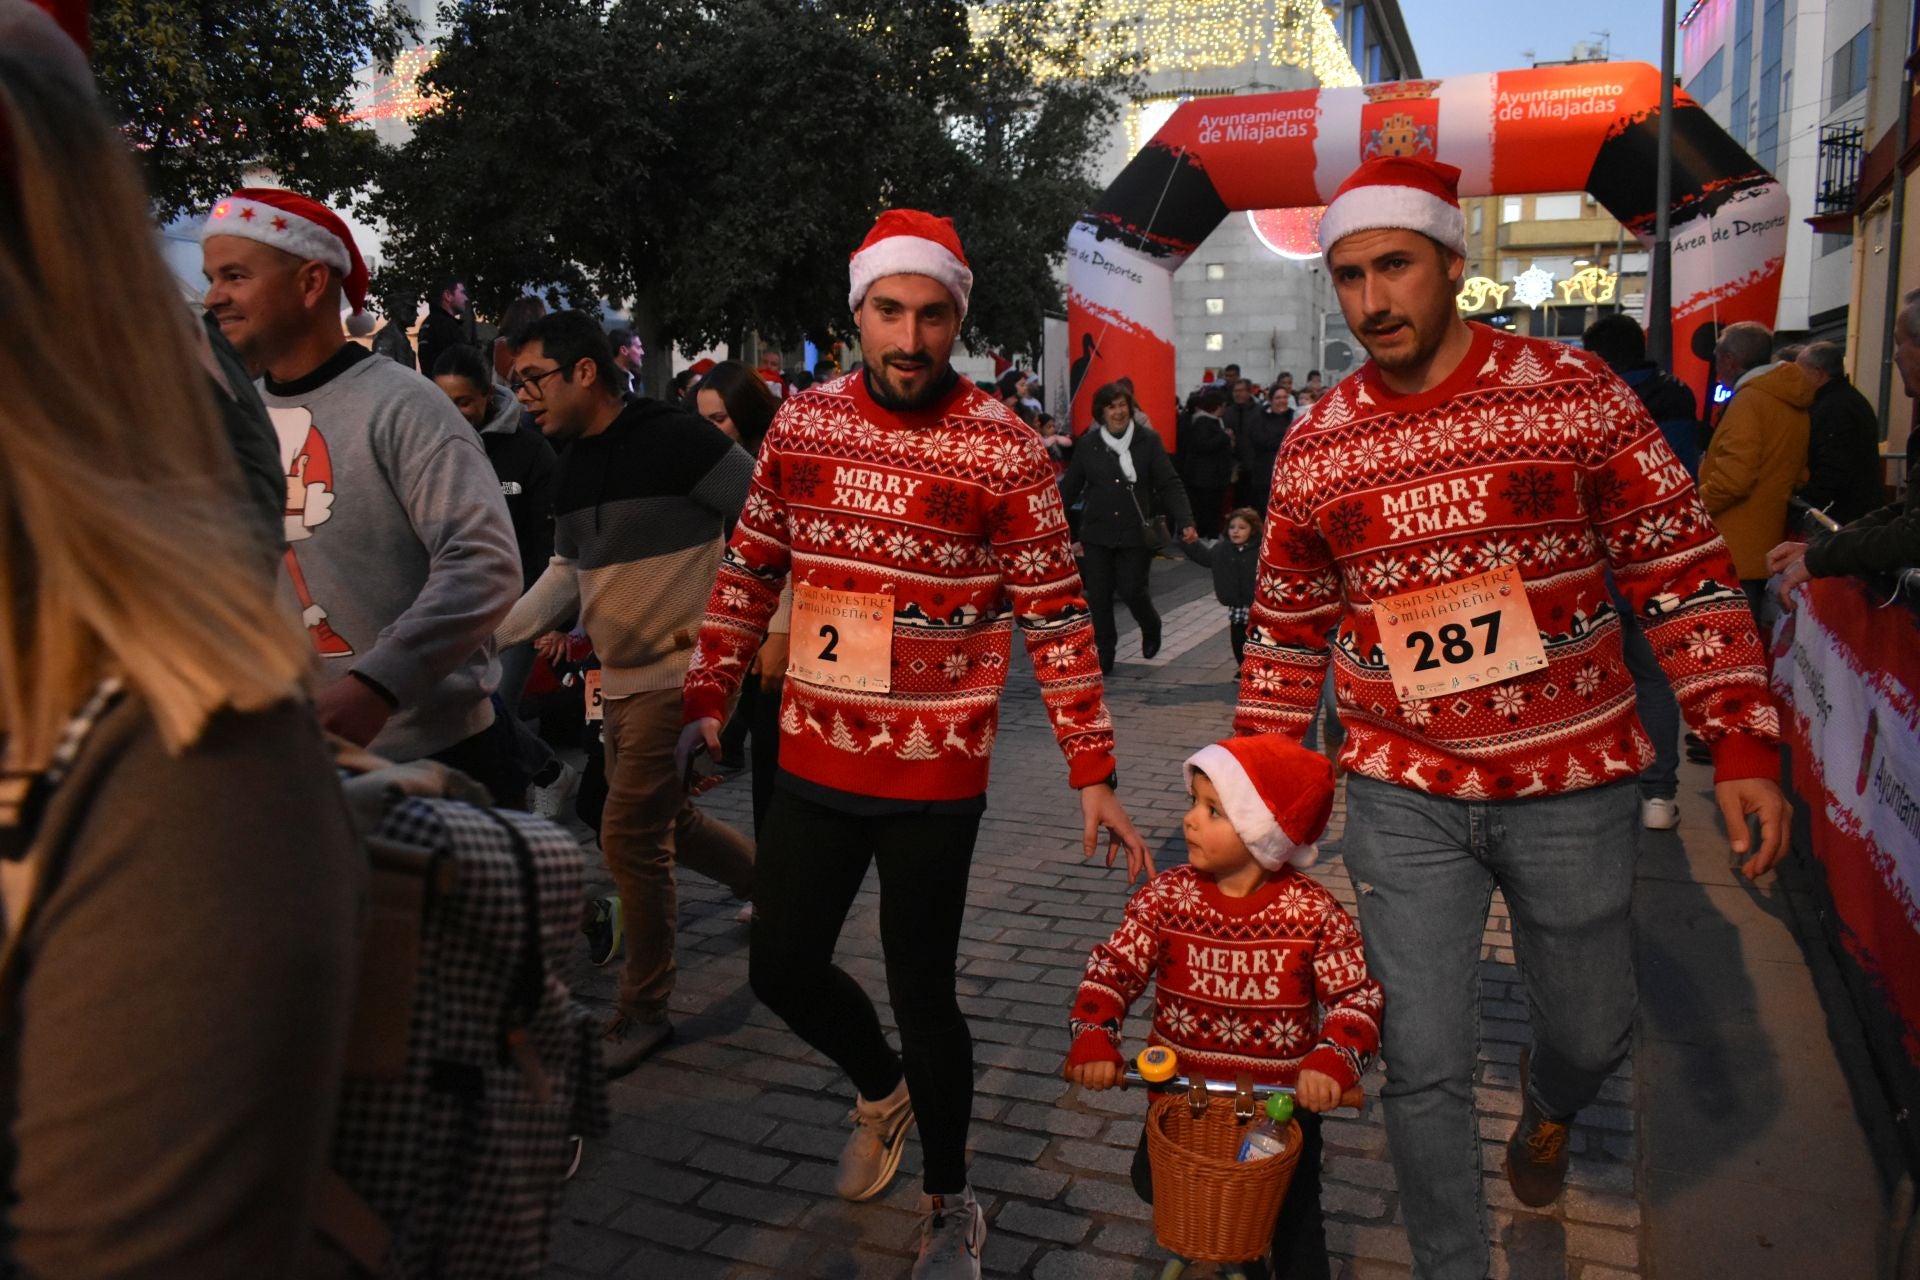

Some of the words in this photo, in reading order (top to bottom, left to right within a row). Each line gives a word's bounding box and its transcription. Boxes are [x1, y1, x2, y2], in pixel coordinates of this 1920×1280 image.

[1498, 84, 1623, 106] Ayuntamiento
[1499, 105, 1523, 121] de
[1528, 97, 1616, 121] Miajadas
[1198, 108, 1315, 131] Ayuntamiento
[1199, 129, 1221, 143] de
[1226, 121, 1308, 144] Miajadas
[1712, 229, 1730, 243] de
[1091, 250, 1143, 284] Deportes
[833, 466, 922, 496] MERRY
[1381, 473, 1494, 517] MERRY
[831, 487, 908, 516] XMAS
[1387, 500, 1487, 540] XMAS
[820, 591, 887, 608] SILVESTRE
[1425, 571, 1512, 603] SILVESTRE
[817, 624, 839, 662] 2
[1406, 610, 1502, 672] 287
[592, 687, 602, 707] 5
[1874, 755, 1920, 846] Ayuntam
[1186, 943, 1291, 974] MERRY
[1188, 969, 1280, 1000] XMAS
